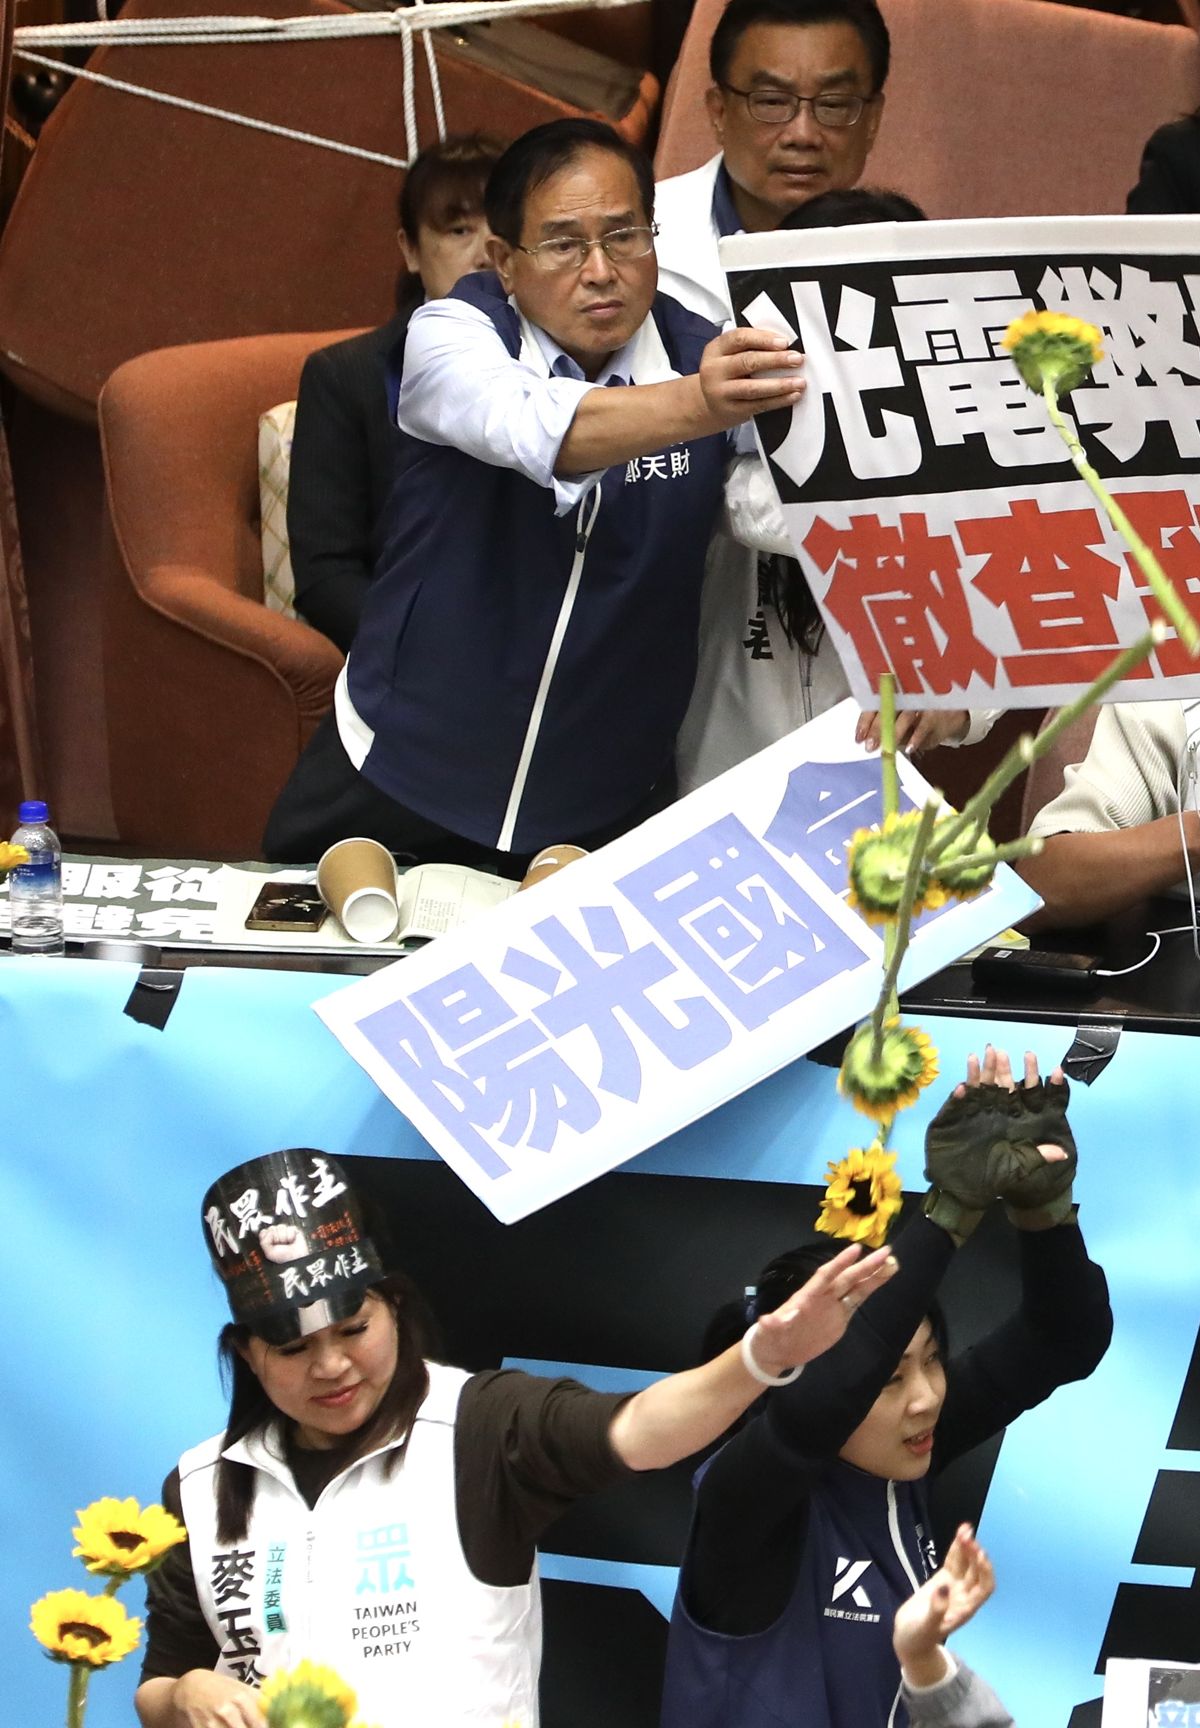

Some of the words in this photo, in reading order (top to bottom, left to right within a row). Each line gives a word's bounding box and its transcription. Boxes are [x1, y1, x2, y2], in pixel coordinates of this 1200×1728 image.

[263, 1545, 287, 1633] 立法委員
[354, 1601, 417, 1620] TAIWAN
[352, 1620, 420, 1640] PEOPLE'S
[364, 1641, 411, 1658] PARTY
